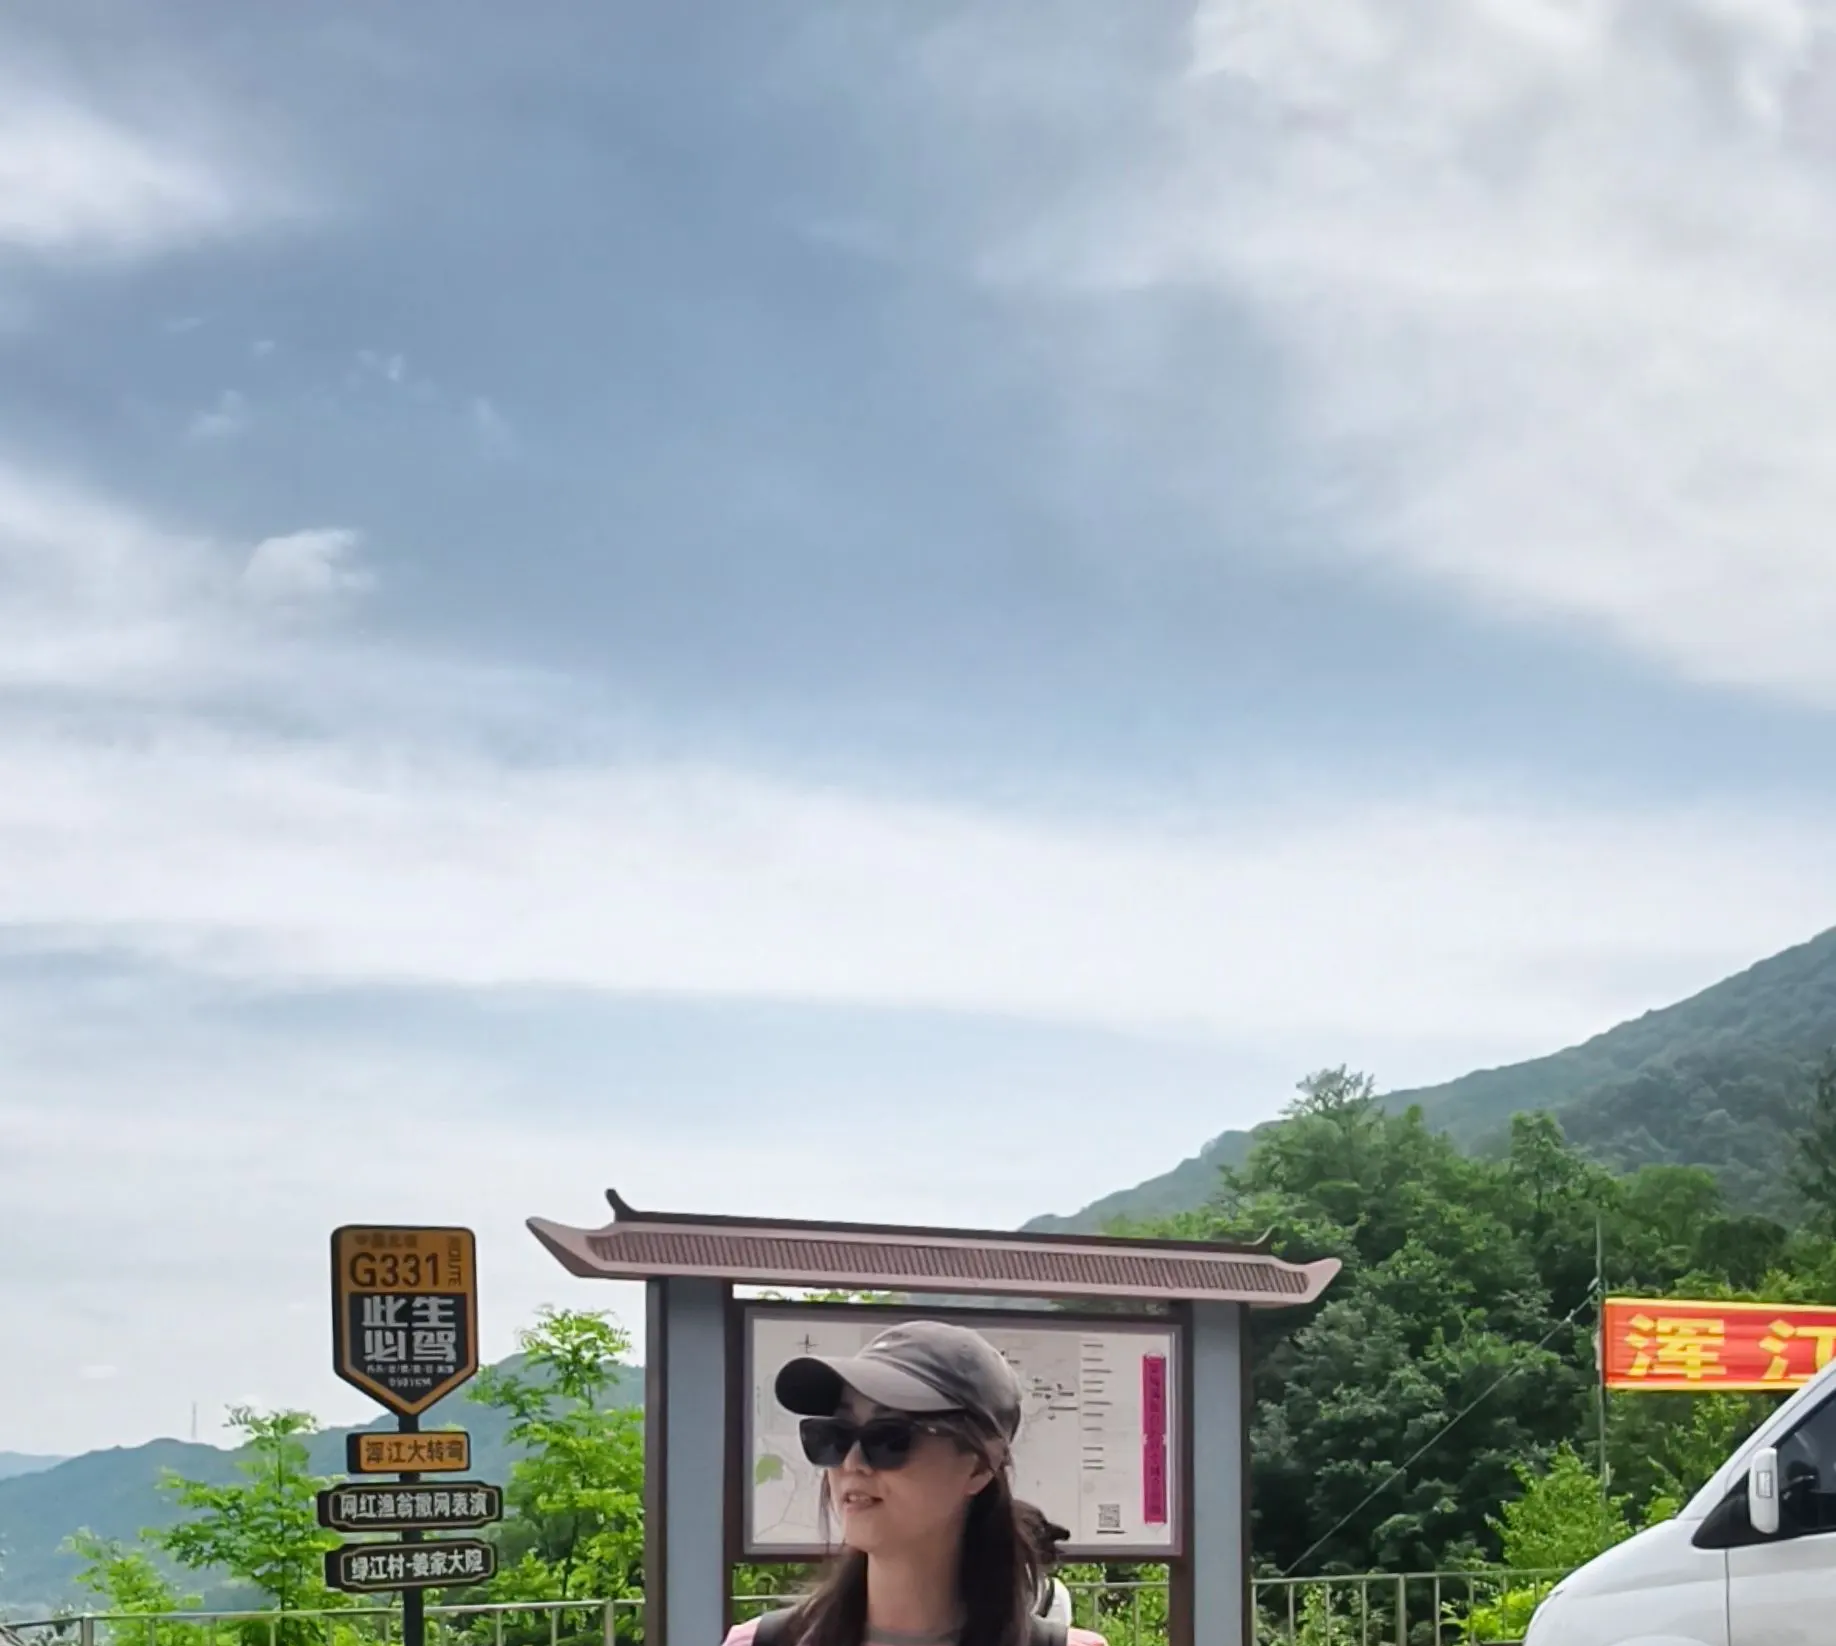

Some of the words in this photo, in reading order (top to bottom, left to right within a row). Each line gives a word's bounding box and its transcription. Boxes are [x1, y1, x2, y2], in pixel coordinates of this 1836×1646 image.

[350, 1252, 439, 1287] G331
[361, 1295, 456, 1328] 此生
[363, 1330, 457, 1362] 必驾
